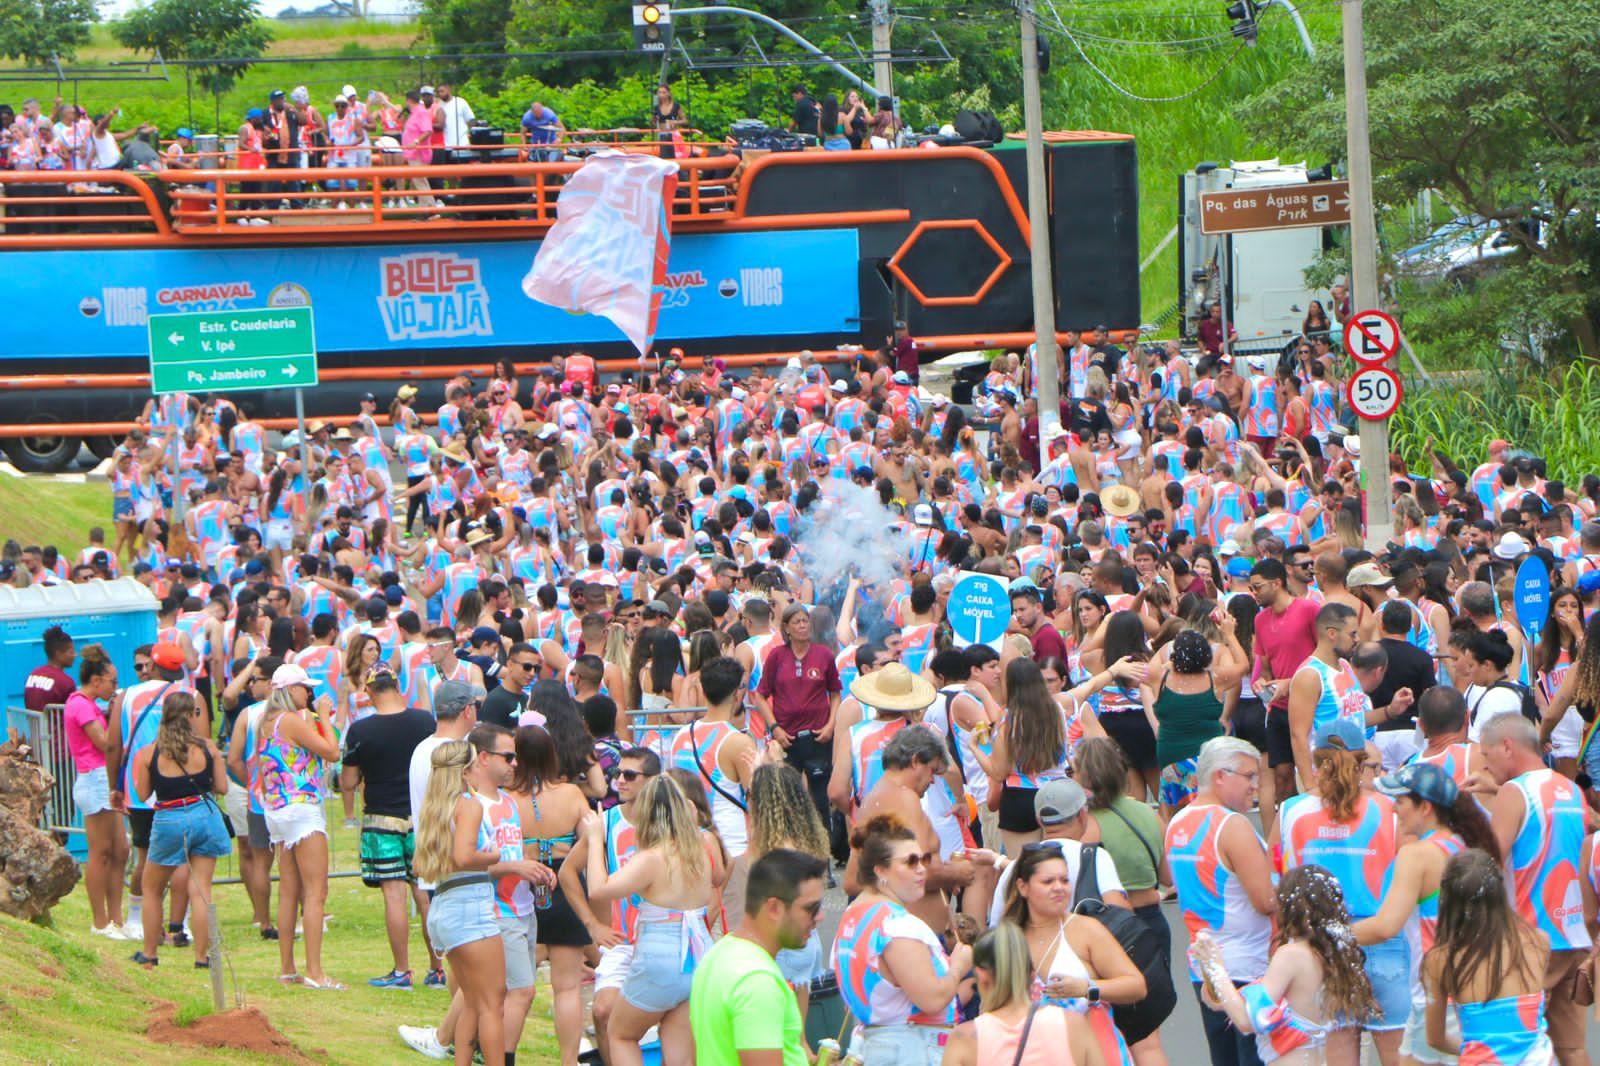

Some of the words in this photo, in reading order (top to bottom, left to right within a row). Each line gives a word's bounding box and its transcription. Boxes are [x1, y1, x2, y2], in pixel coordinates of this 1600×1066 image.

[1206, 201, 1228, 213] Pq.
[1233, 198, 1257, 209] das
[1266, 193, 1308, 208] Águas
[385, 256, 476, 297] BLOCO
[156, 282, 254, 305] CARNAVAL
[383, 292, 418, 334] VÔ
[418, 283, 487, 332] JAJÁ
[199, 321, 227, 333] Estr.
[231, 318, 296, 332] Coudelaria
[1362, 321, 1382, 354] E
[201, 341, 212, 351] V.
[216, 339, 236, 353] Ipê
[187, 370, 206, 384] Pq.
[210, 368, 267, 382] Jambeiro
[1358, 378, 1391, 402] 50
[1524, 579, 1541, 588] CAIXA
[966, 595, 993, 605] CAIXA
[1523, 594, 1542, 603] MÓVEL
[963, 607, 994, 618] MÓVEL
